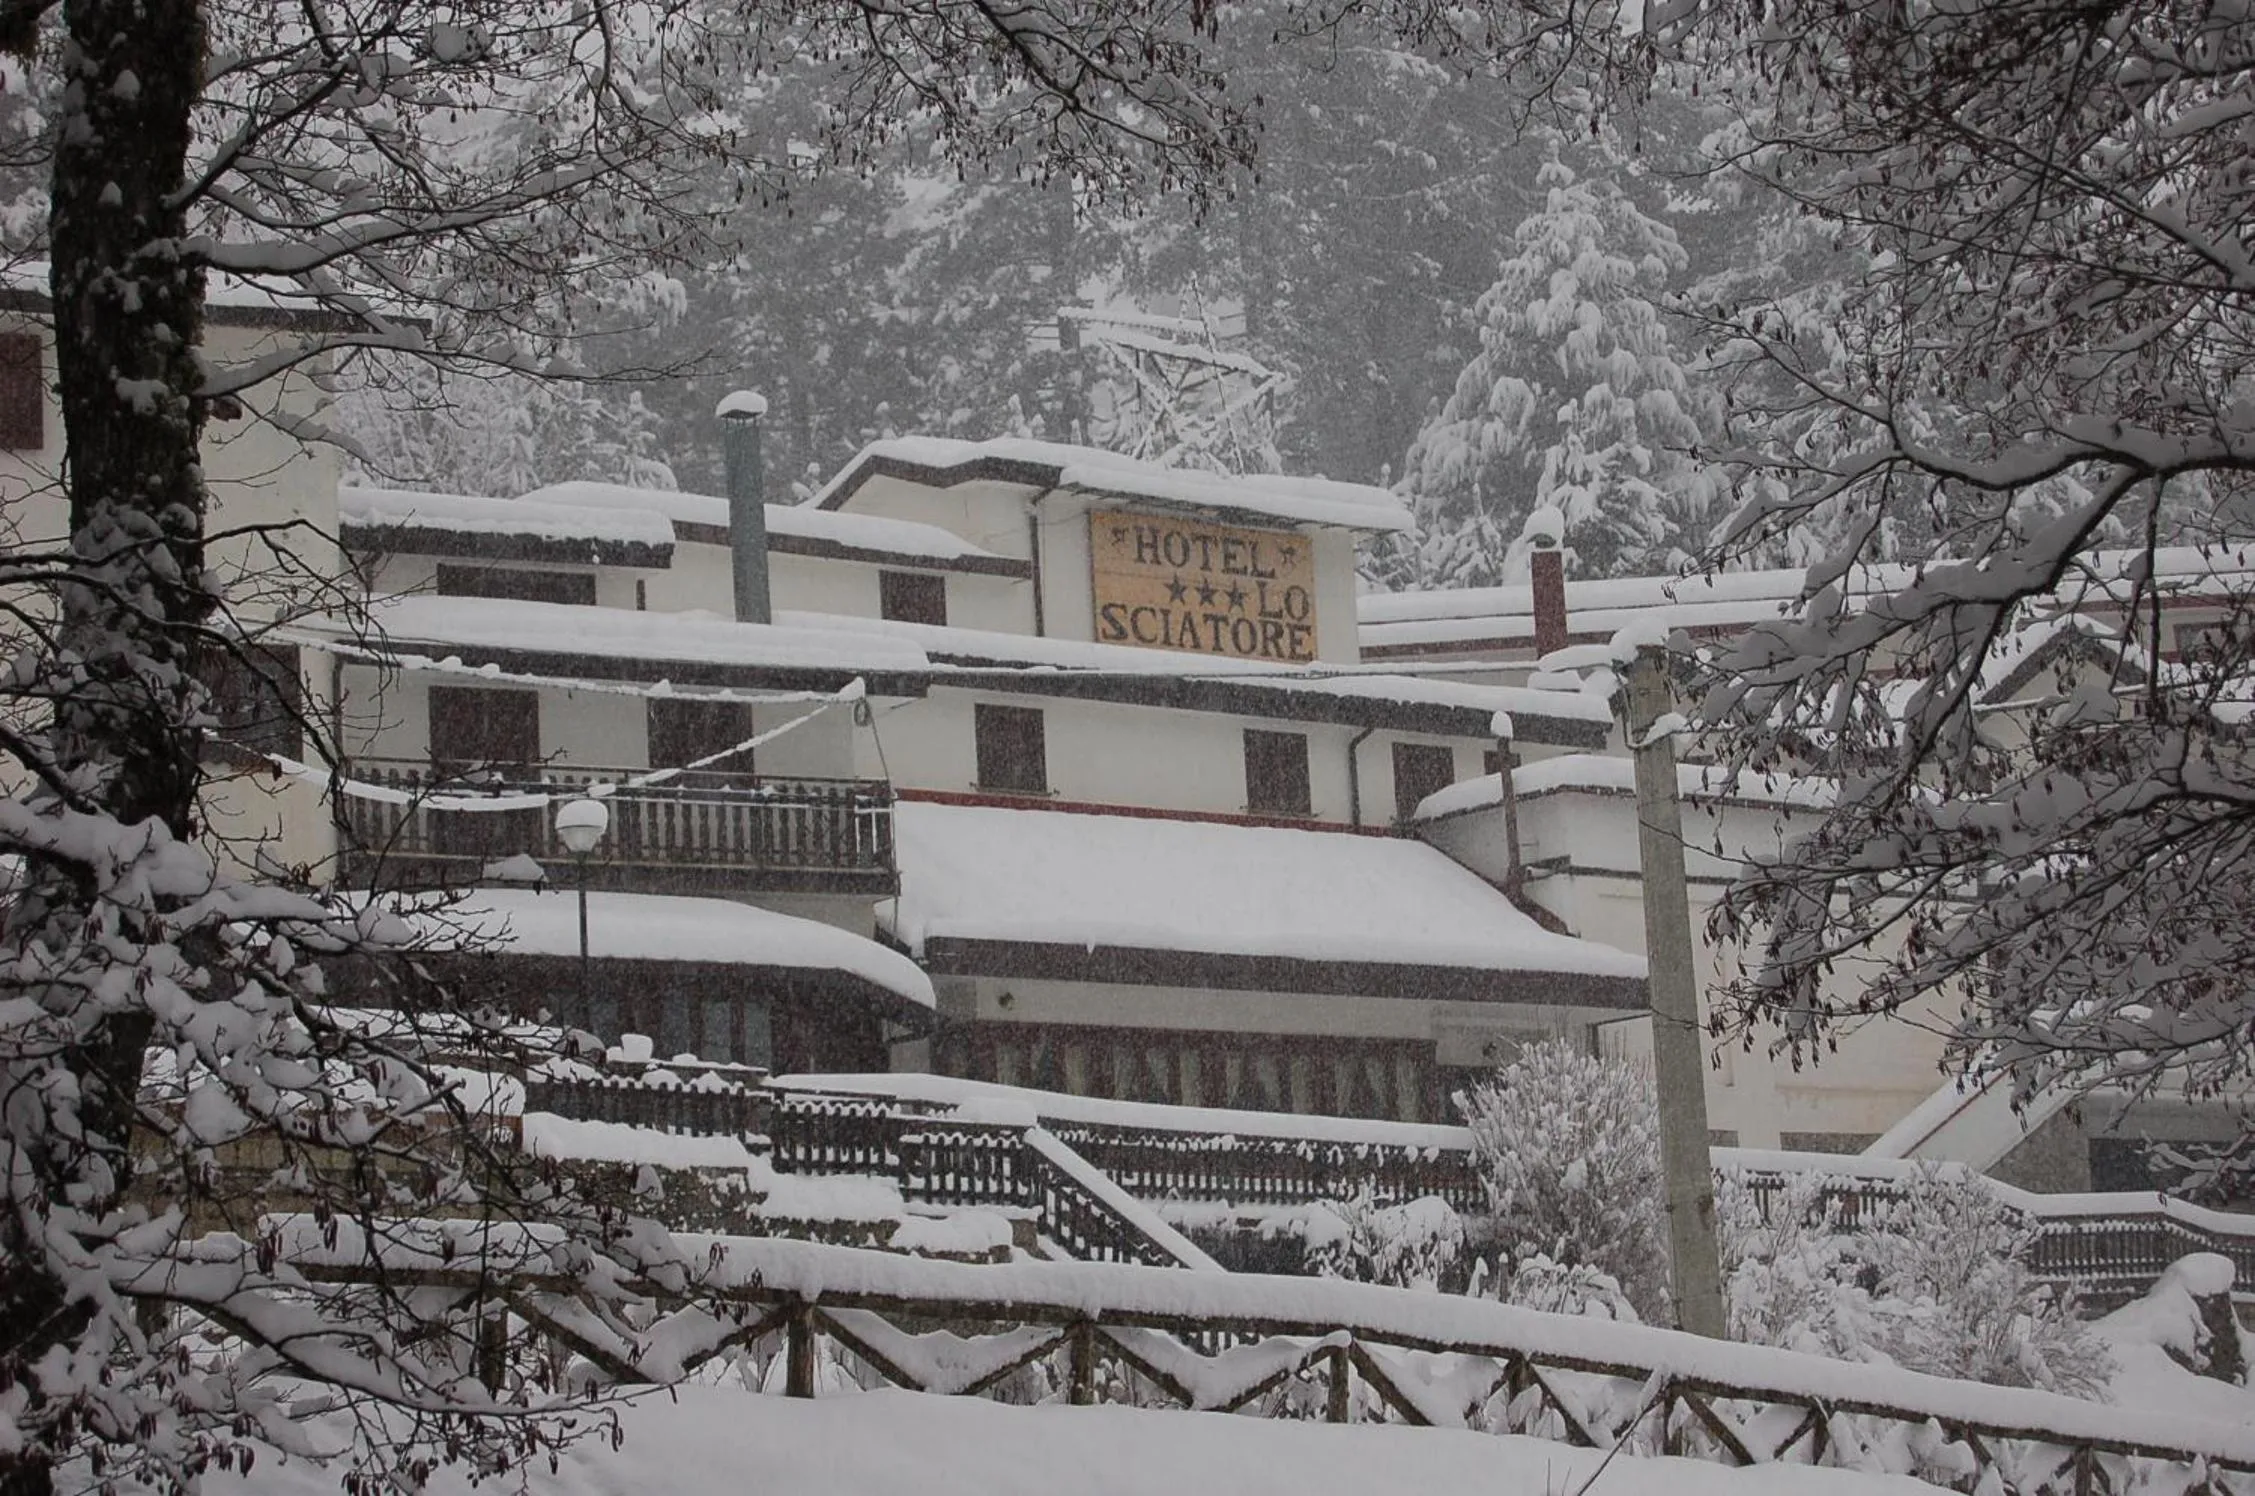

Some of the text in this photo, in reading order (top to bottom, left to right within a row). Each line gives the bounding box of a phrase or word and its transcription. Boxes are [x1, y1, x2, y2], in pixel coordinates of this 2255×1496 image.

[1134, 525, 1276, 578] HOTEL
[1256, 580, 1309, 621] LO
[1101, 603, 1312, 661] SCIATORE
